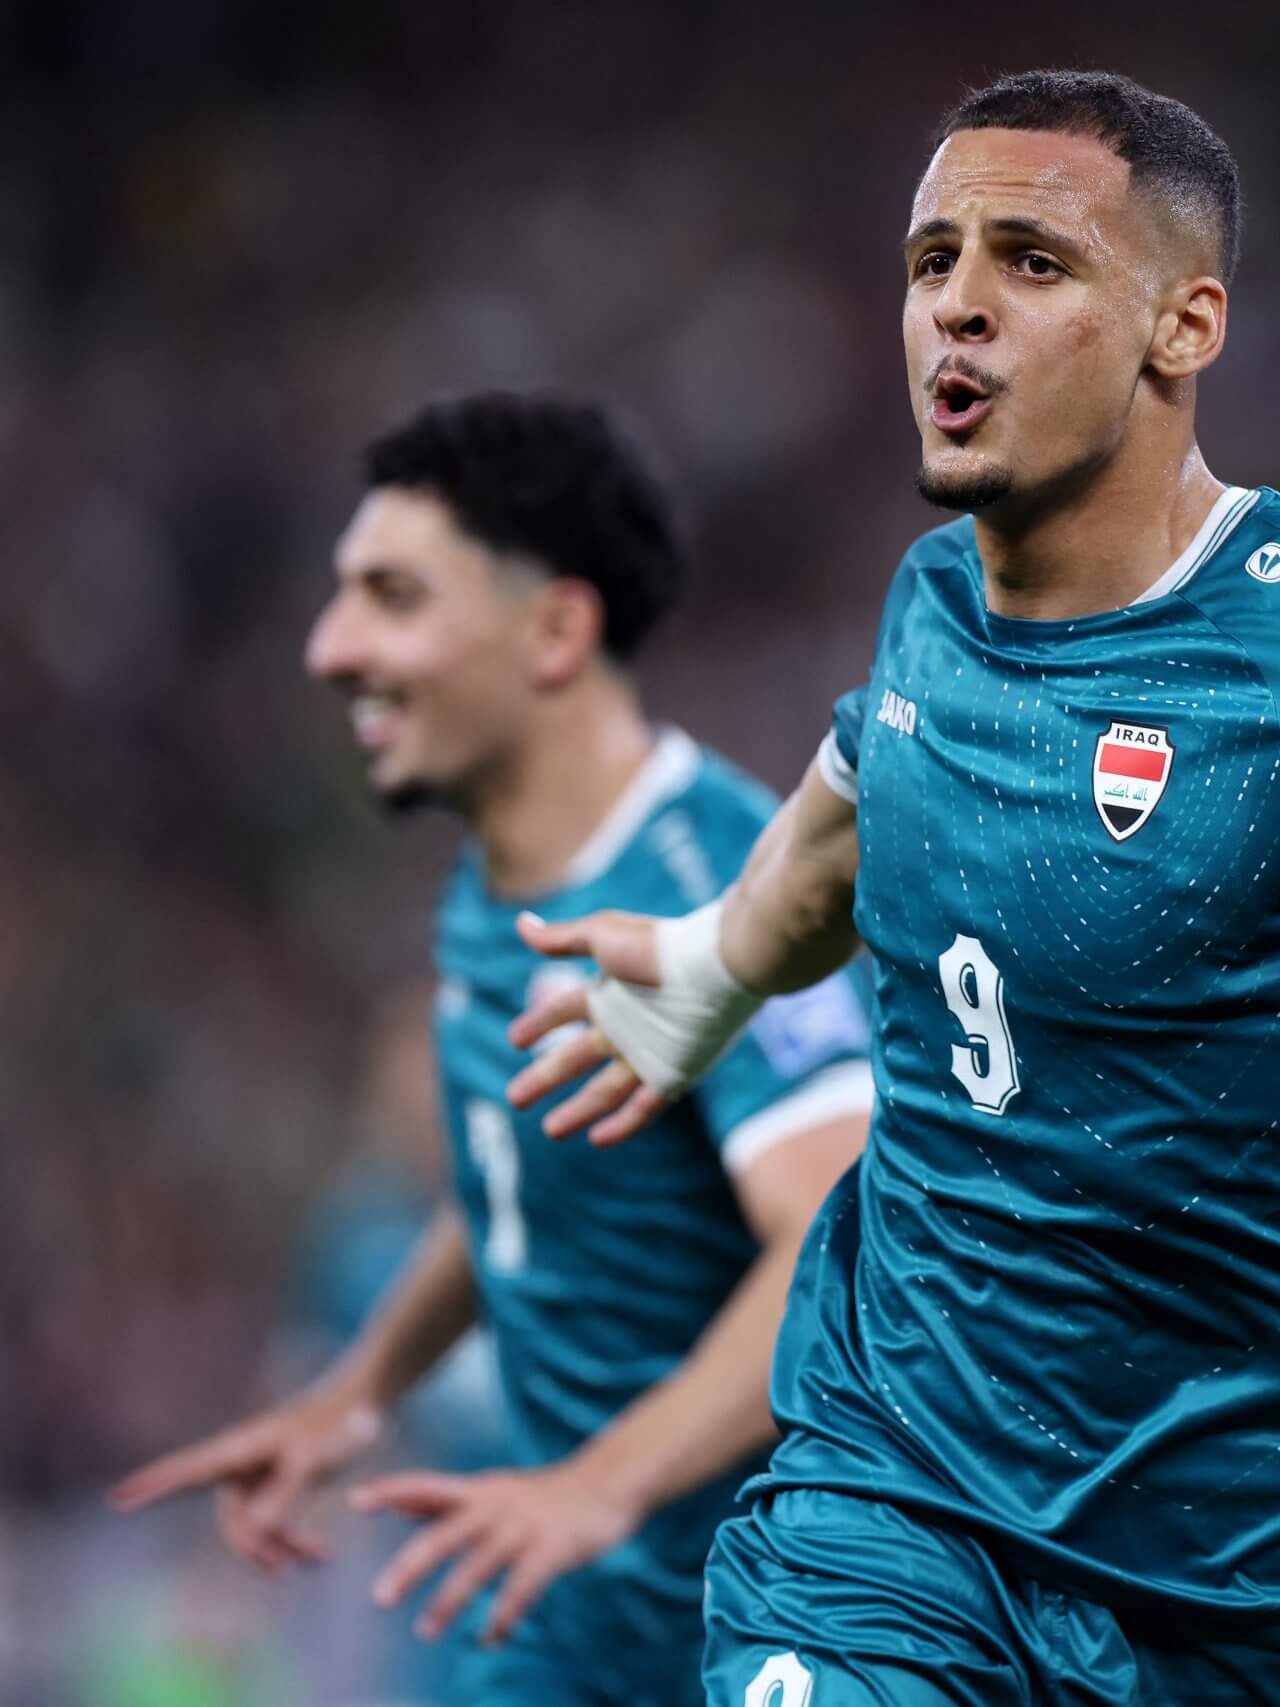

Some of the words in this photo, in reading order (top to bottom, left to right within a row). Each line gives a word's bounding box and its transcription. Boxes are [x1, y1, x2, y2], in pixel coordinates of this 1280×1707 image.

[876, 688, 917, 736] JAKO
[1115, 727, 1160, 746] IRAQ
[938, 933, 1021, 1116] 9
